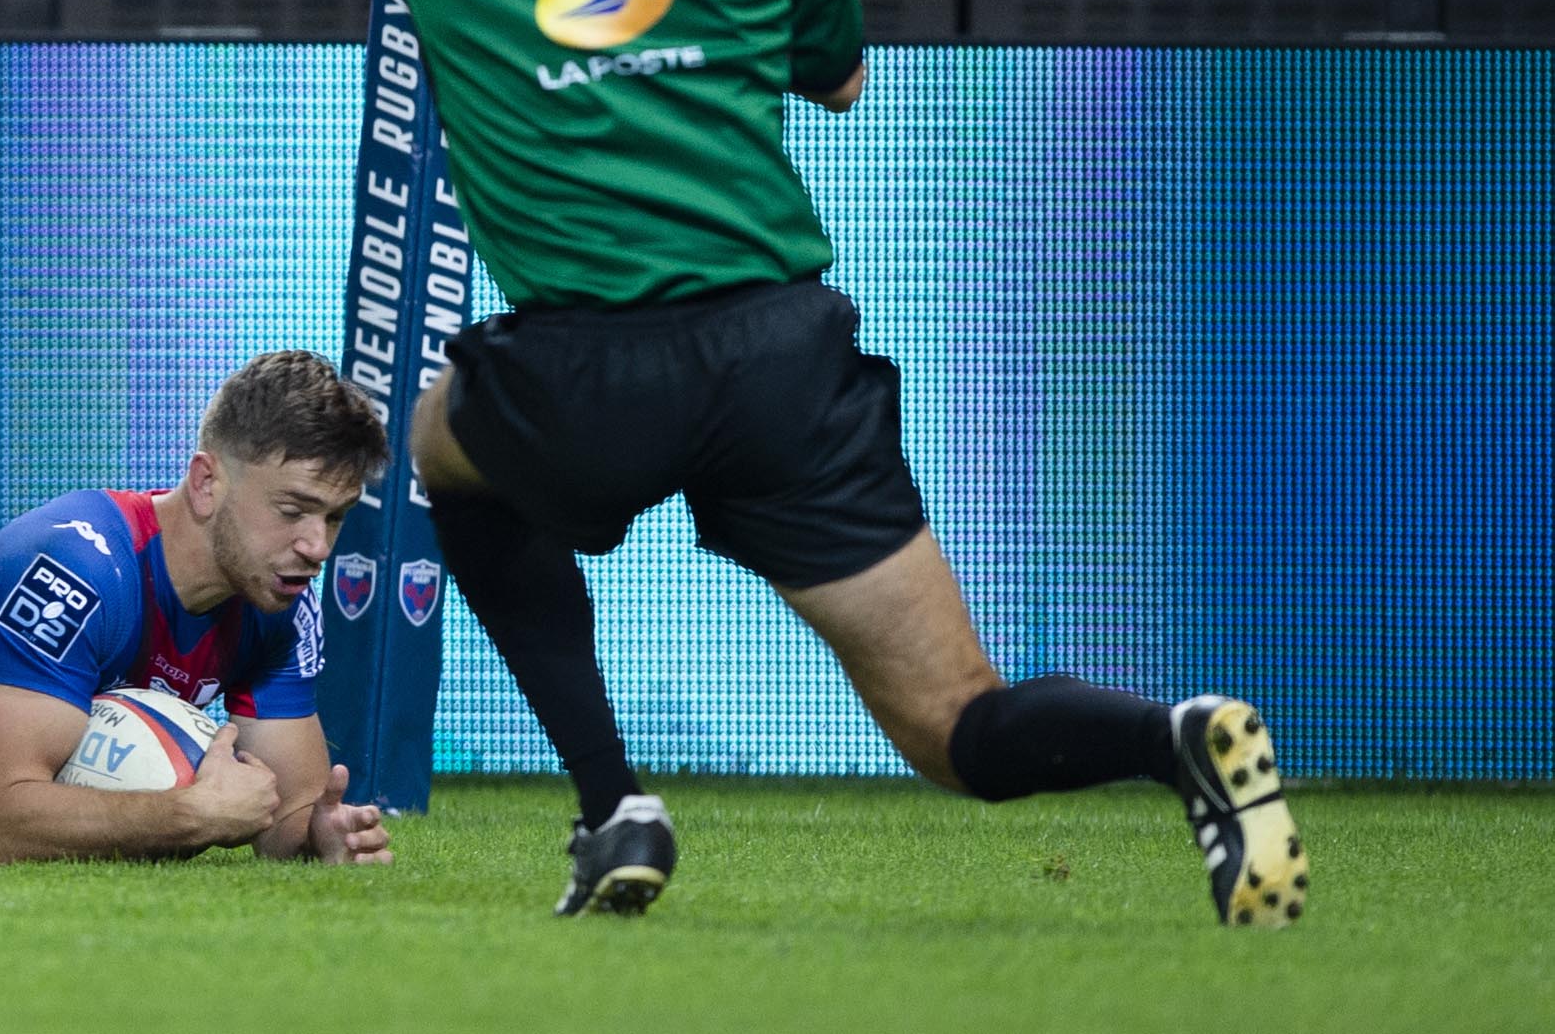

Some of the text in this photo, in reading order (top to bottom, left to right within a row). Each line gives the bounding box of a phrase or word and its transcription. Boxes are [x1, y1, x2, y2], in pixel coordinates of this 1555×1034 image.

[536, 44, 706, 90] LA POSTE
[32, 566, 88, 610] PRO
[9, 595, 67, 648] D2
[78, 730, 136, 773] AD
